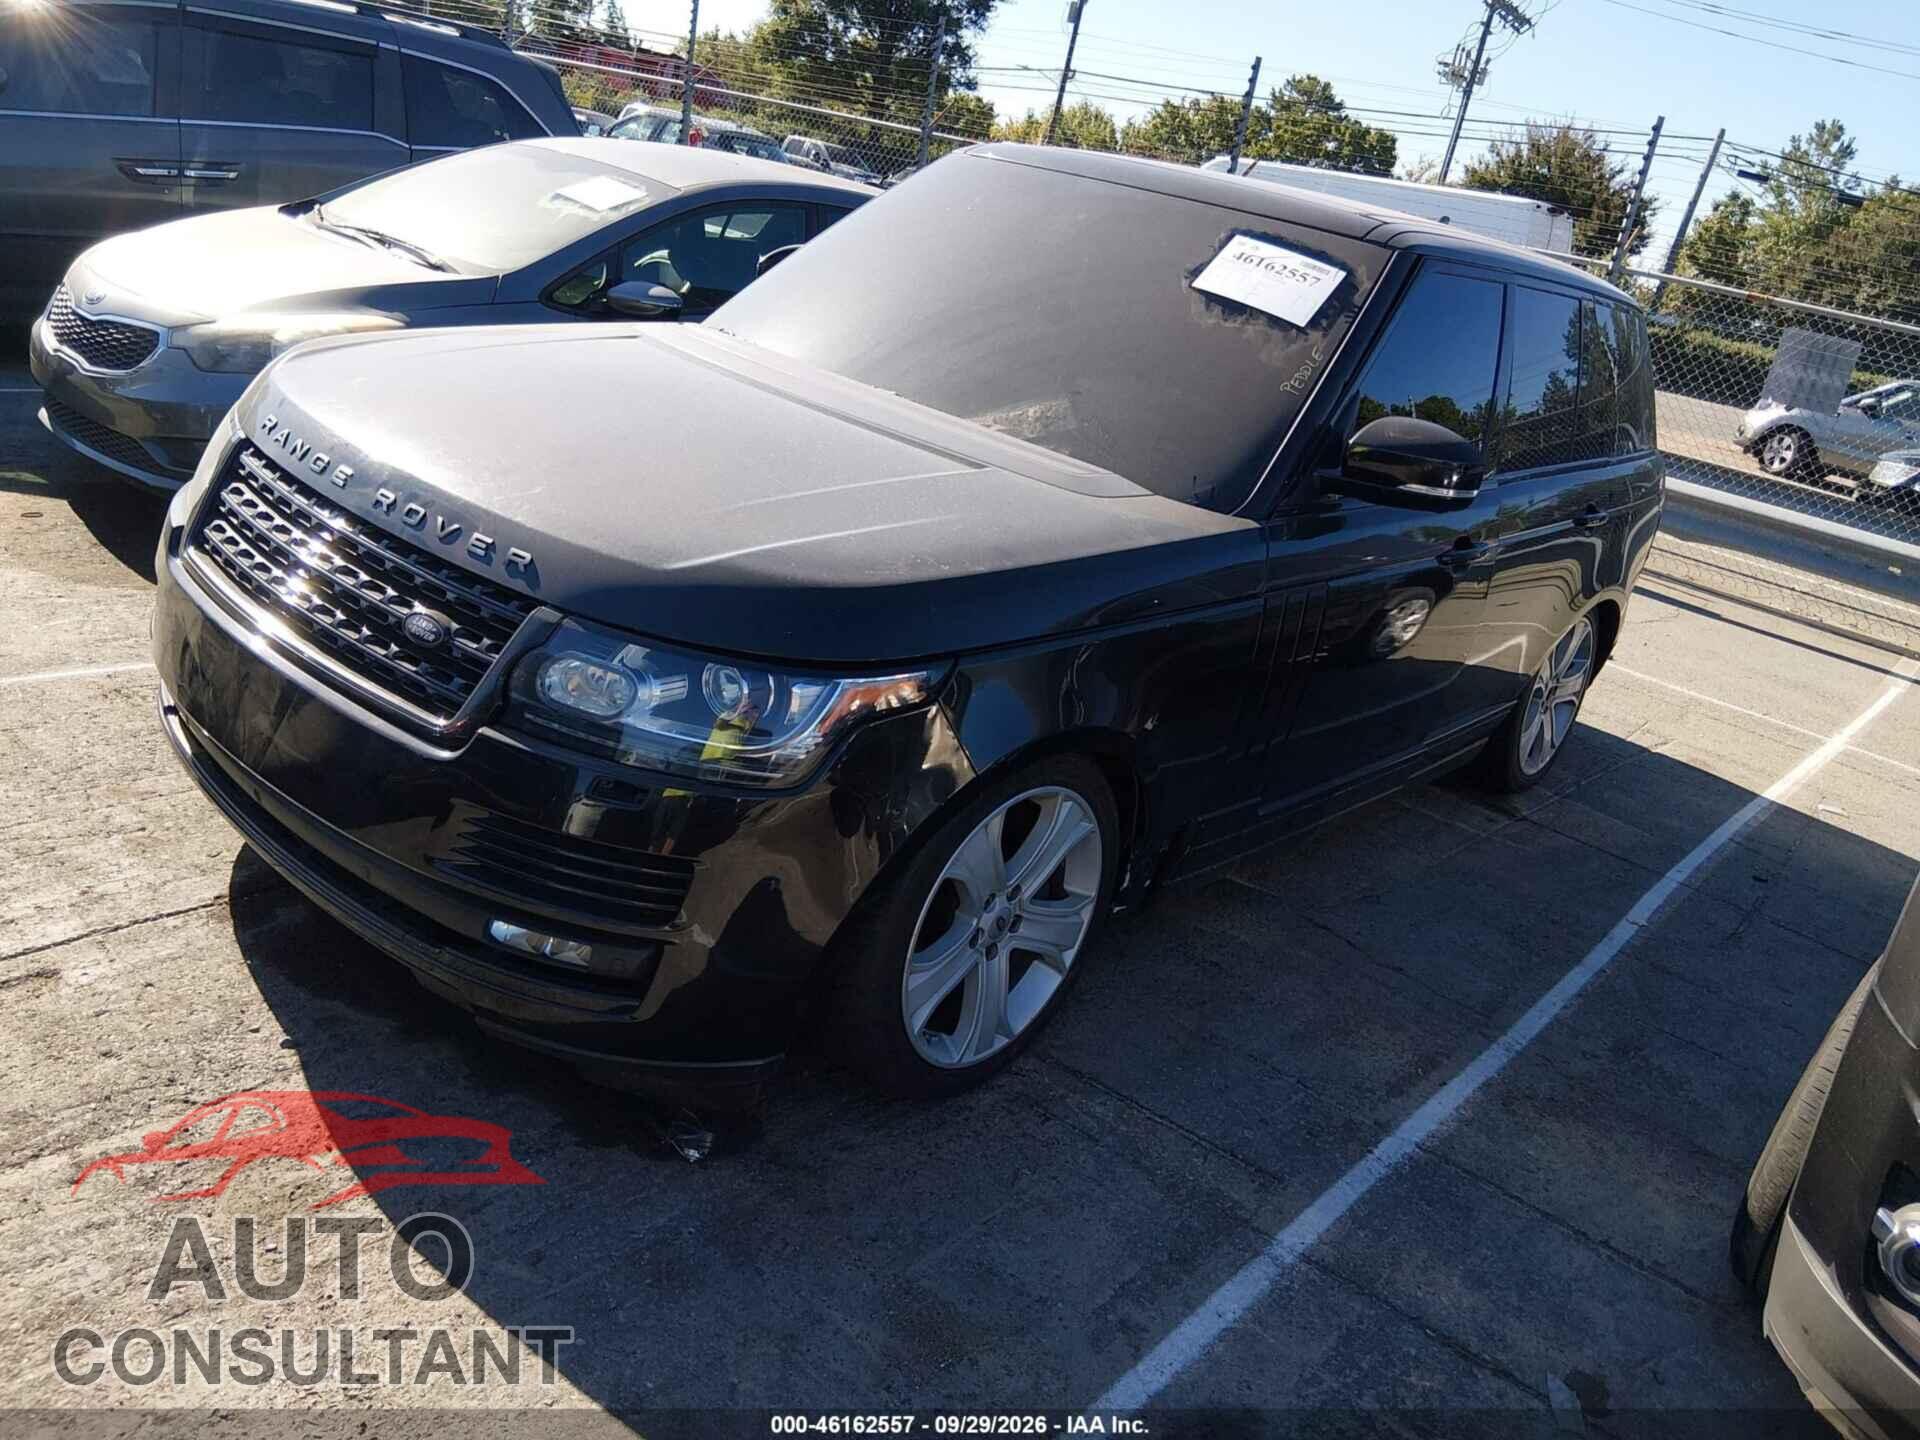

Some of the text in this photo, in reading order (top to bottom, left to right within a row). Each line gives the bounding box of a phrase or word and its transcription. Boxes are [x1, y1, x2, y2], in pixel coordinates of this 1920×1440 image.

[1280, 345, 1324, 395] PEDDLE
[260, 413, 535, 573] RANGE ROVER
